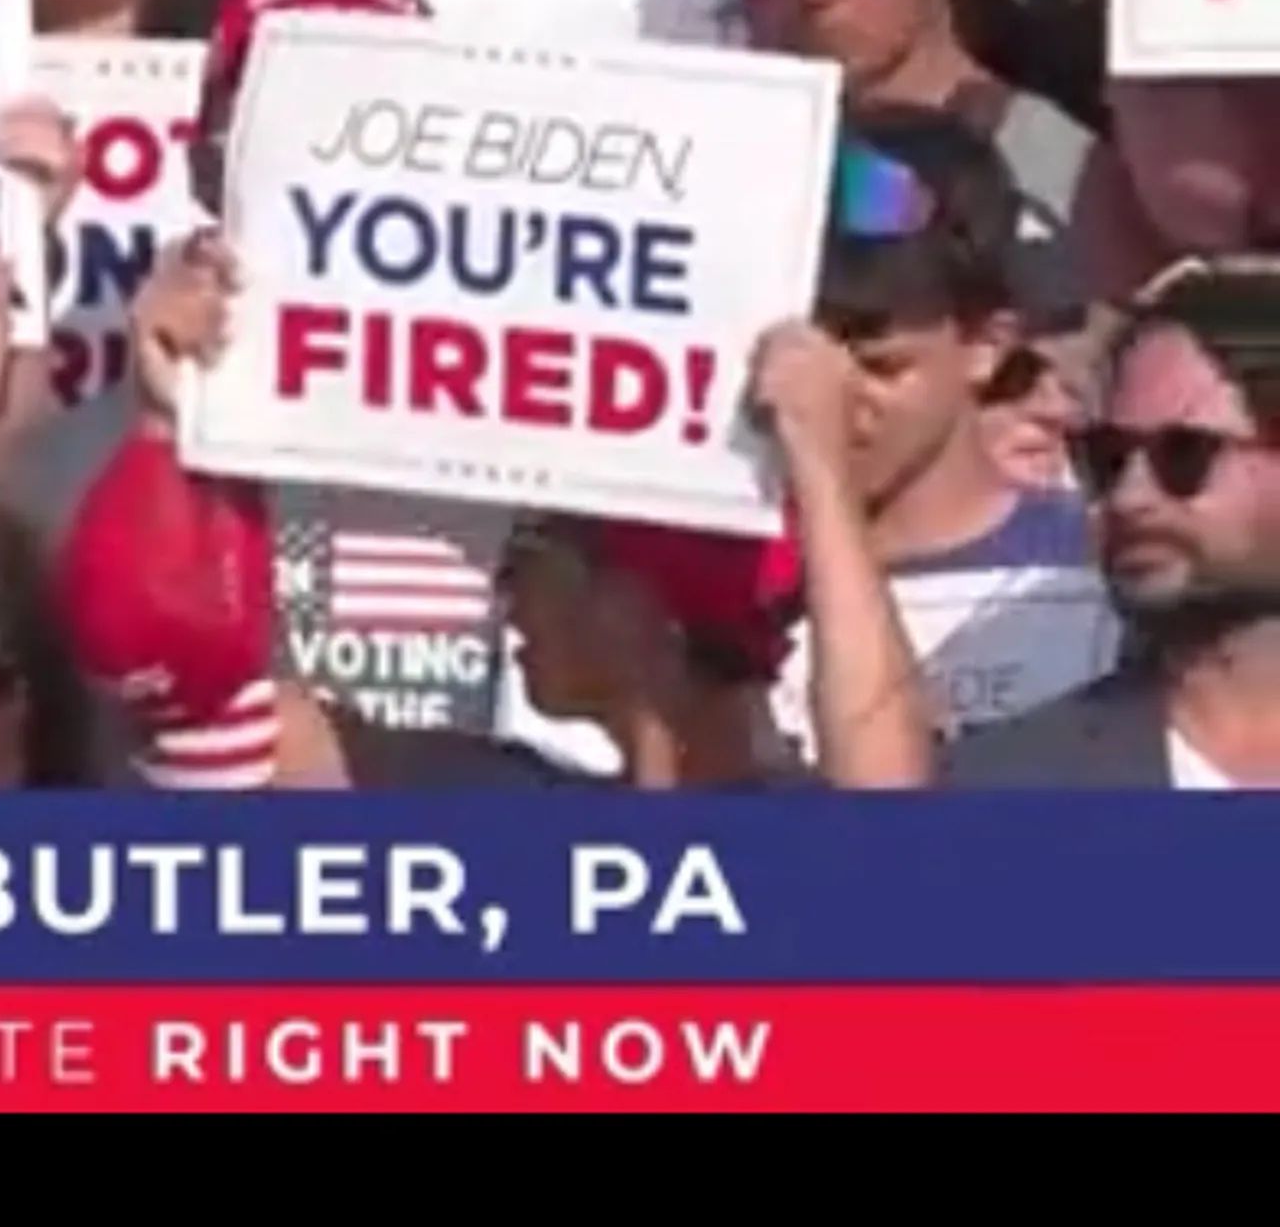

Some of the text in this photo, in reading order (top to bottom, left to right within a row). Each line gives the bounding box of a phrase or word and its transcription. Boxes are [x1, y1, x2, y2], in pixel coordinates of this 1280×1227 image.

[309, 98, 468, 174] JOE
[463, 108, 692, 200] BIDEN,
[288, 184, 695, 314] YOU'RE
[271, 302, 716, 446] FIRED!
[288, 629, 488, 686] VOTING
